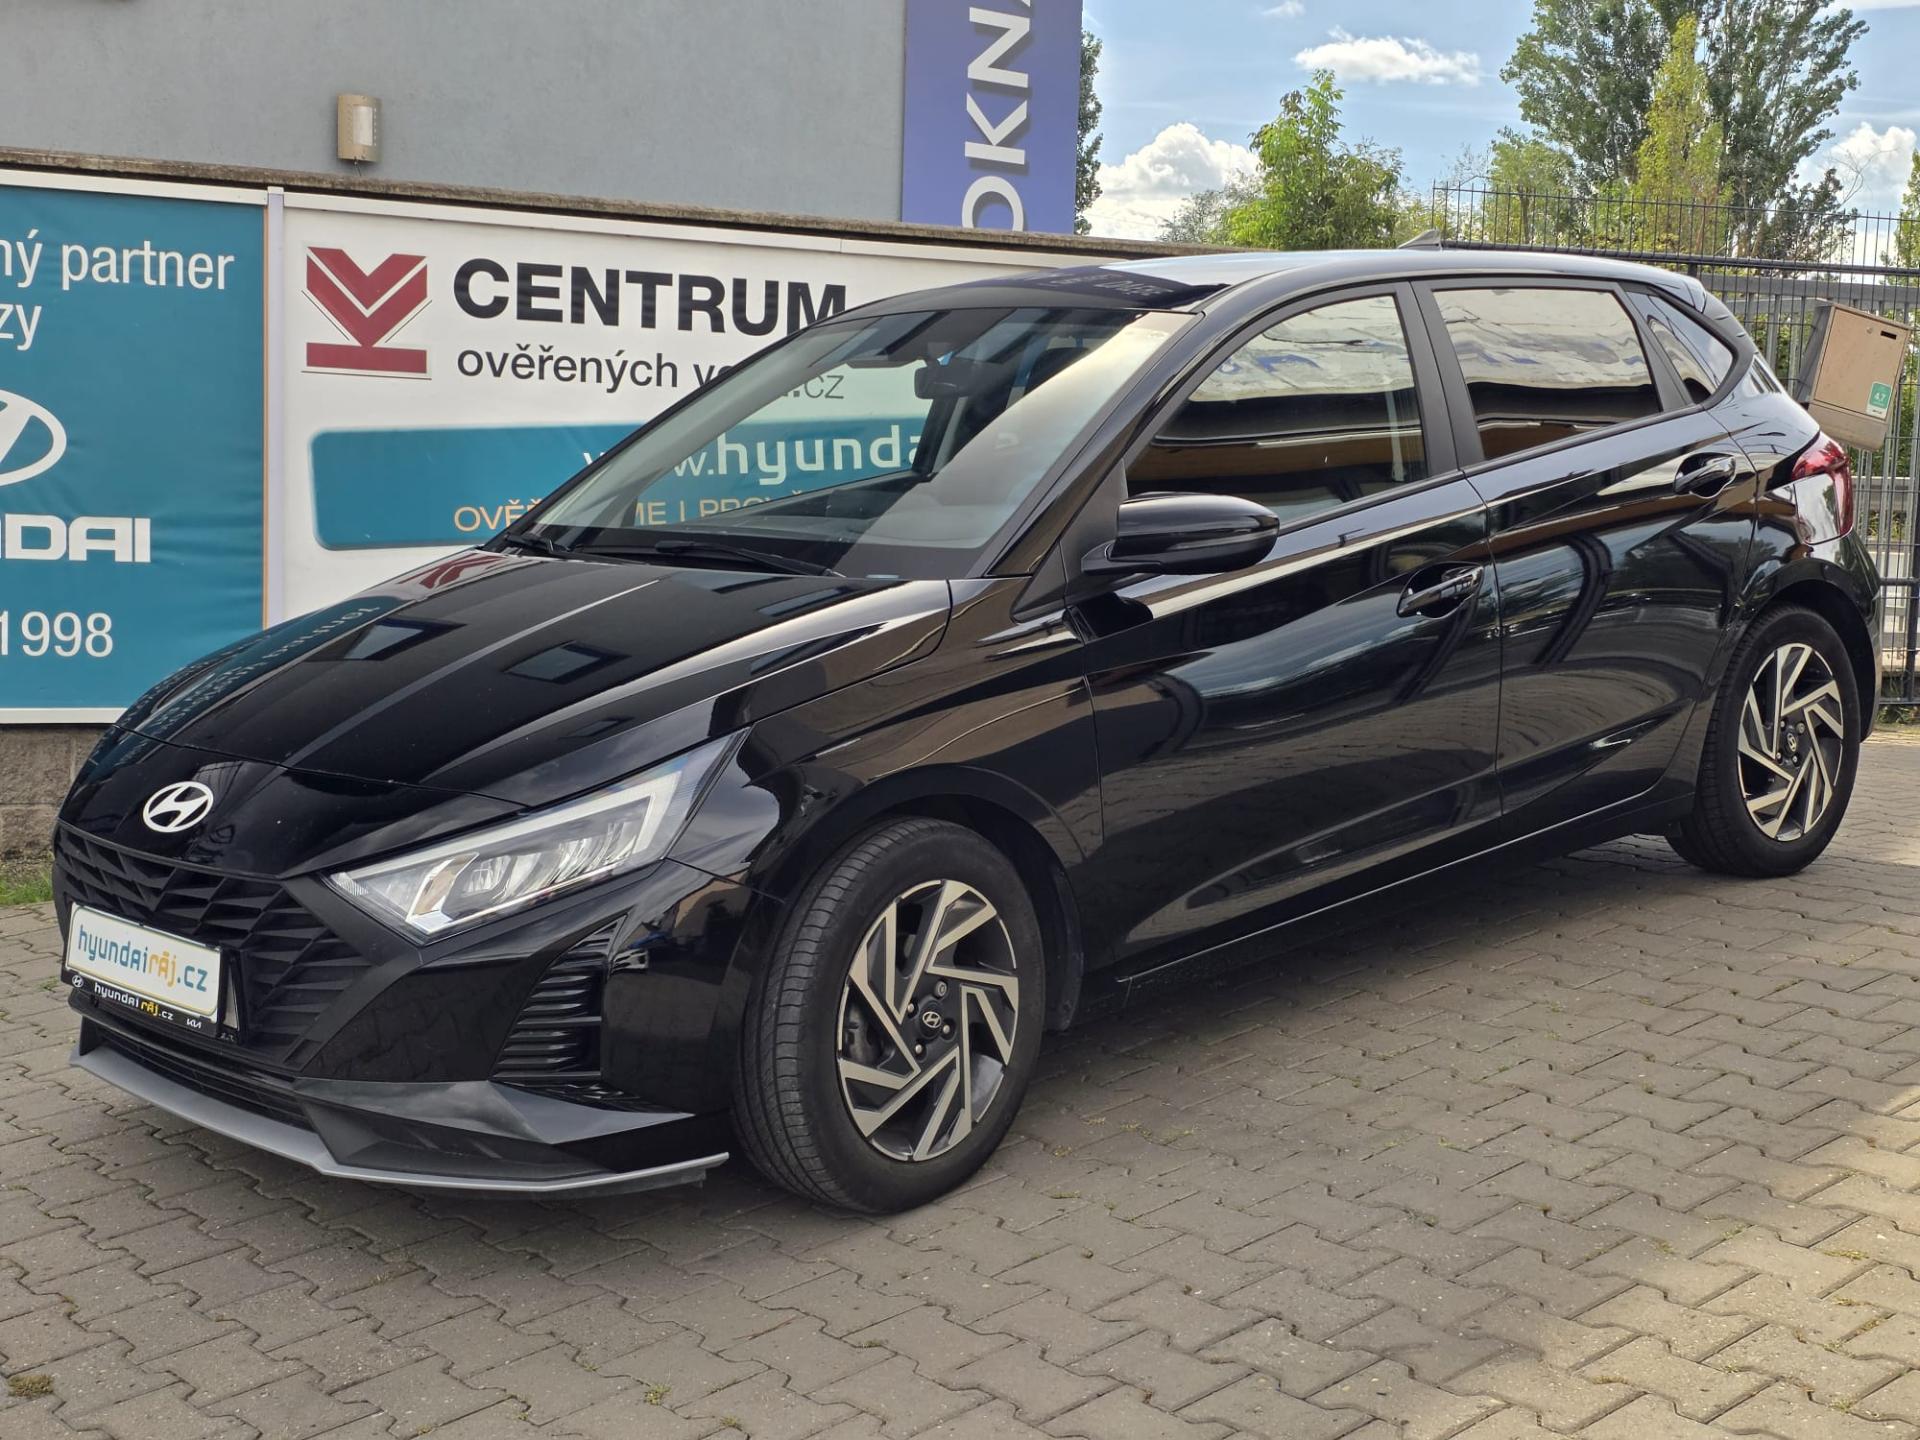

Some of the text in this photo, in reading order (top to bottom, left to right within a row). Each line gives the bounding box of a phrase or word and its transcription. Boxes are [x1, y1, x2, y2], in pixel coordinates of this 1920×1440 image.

[962, 0, 1031, 232] OKN
[61, 240, 235, 290] partner
[453, 258, 847, 337] CENTRUM
[457, 343, 678, 394] ověřených
[0, 513, 151, 563] DAI
[0, 610, 113, 658] 1998
